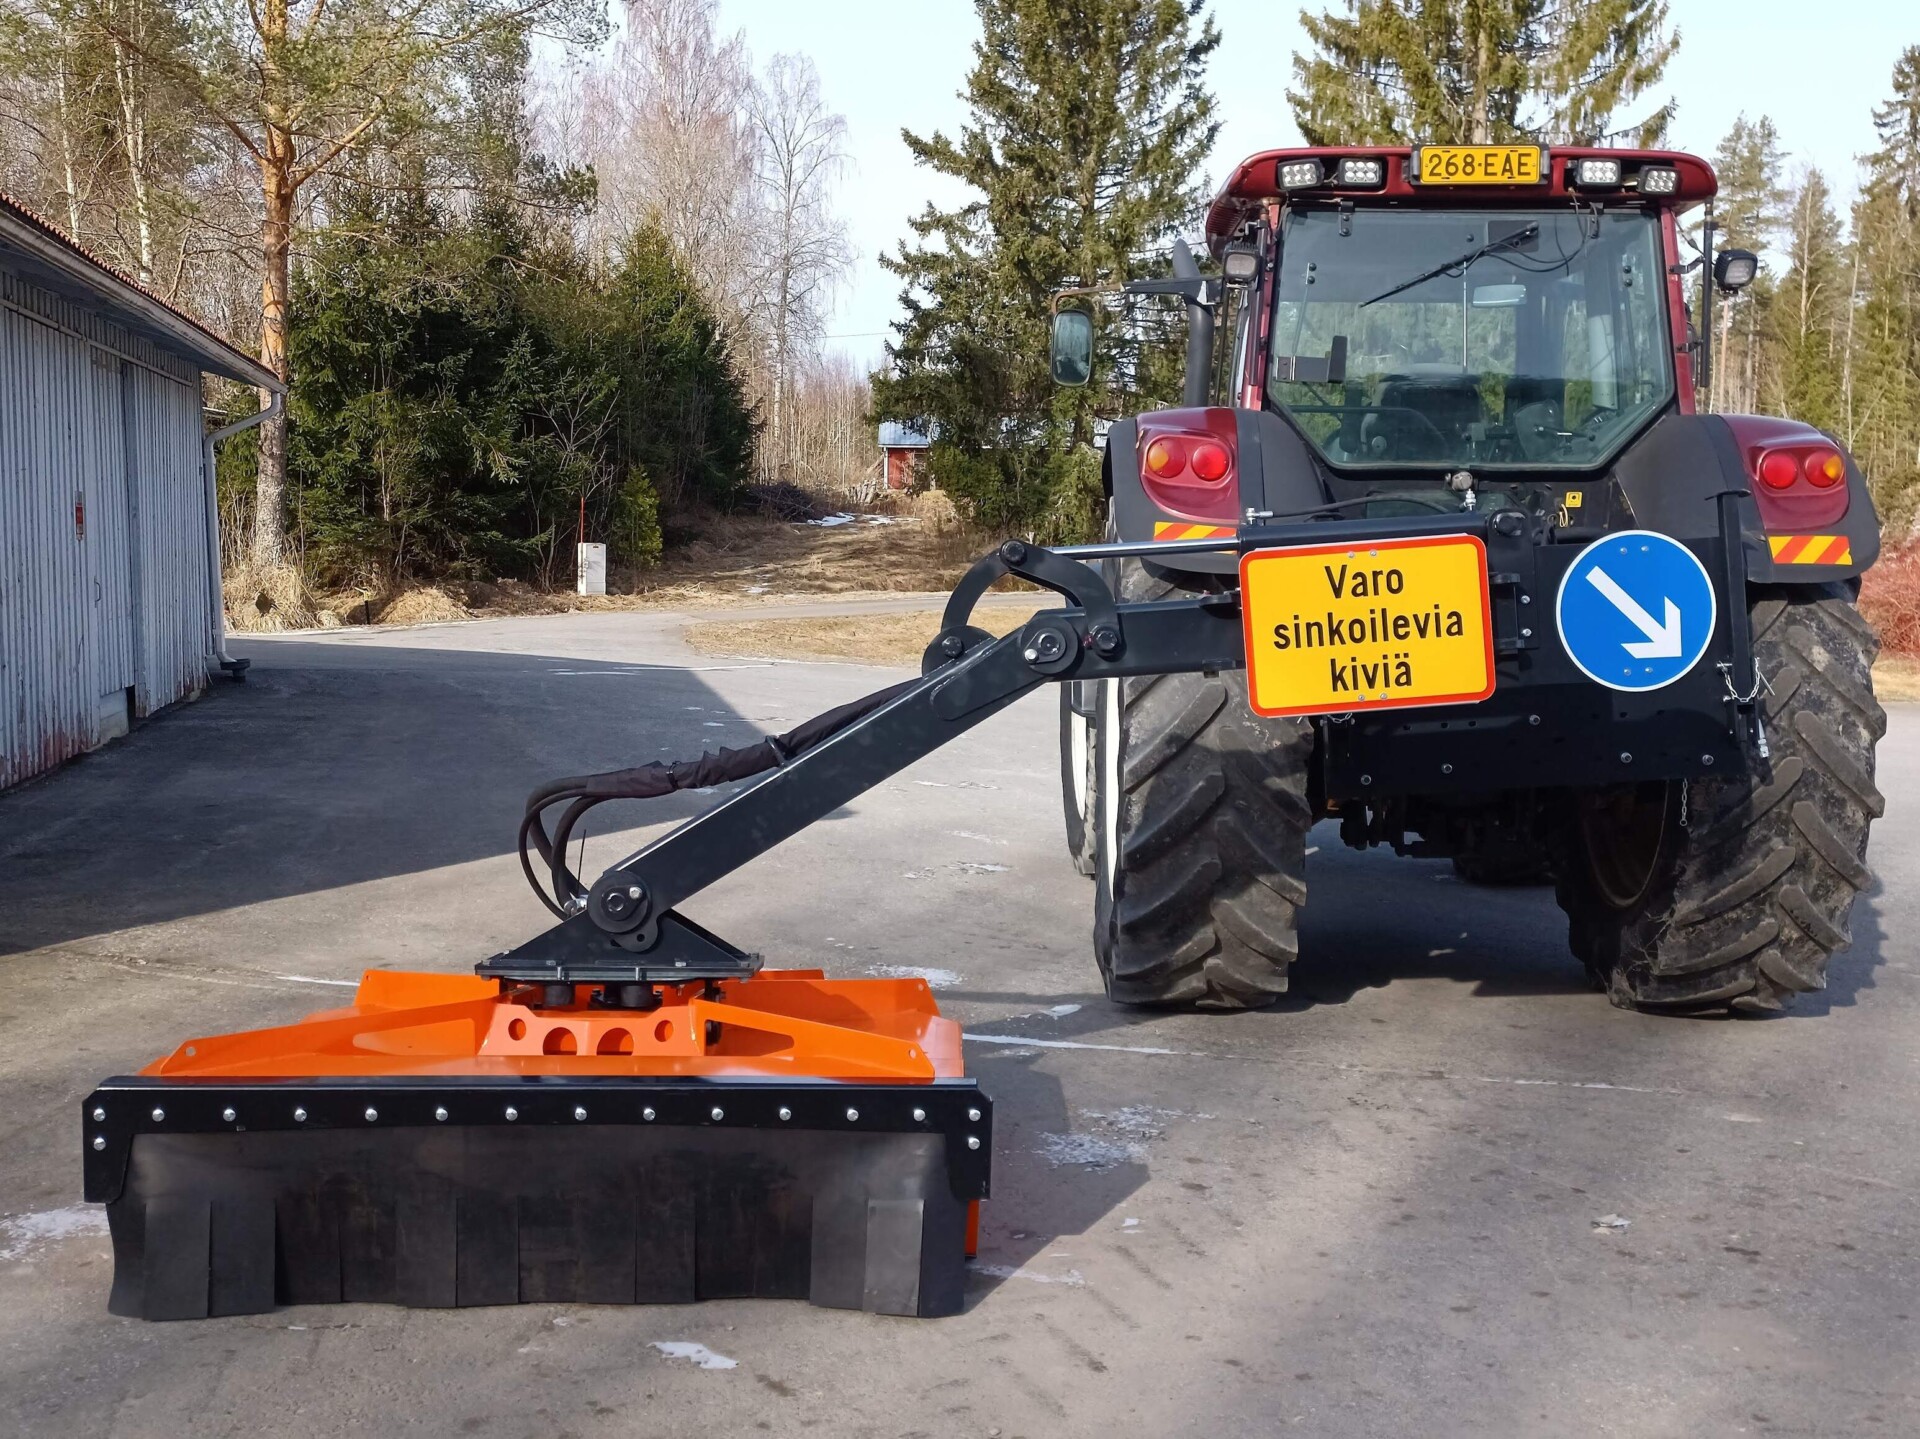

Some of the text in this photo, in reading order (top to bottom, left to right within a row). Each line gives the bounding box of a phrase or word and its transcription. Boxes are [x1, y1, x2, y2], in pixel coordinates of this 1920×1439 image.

[1324, 564, 1404, 599] Varo
[1273, 604, 1463, 650] sinkoilevia
[1330, 652, 1412, 692] kiviä
